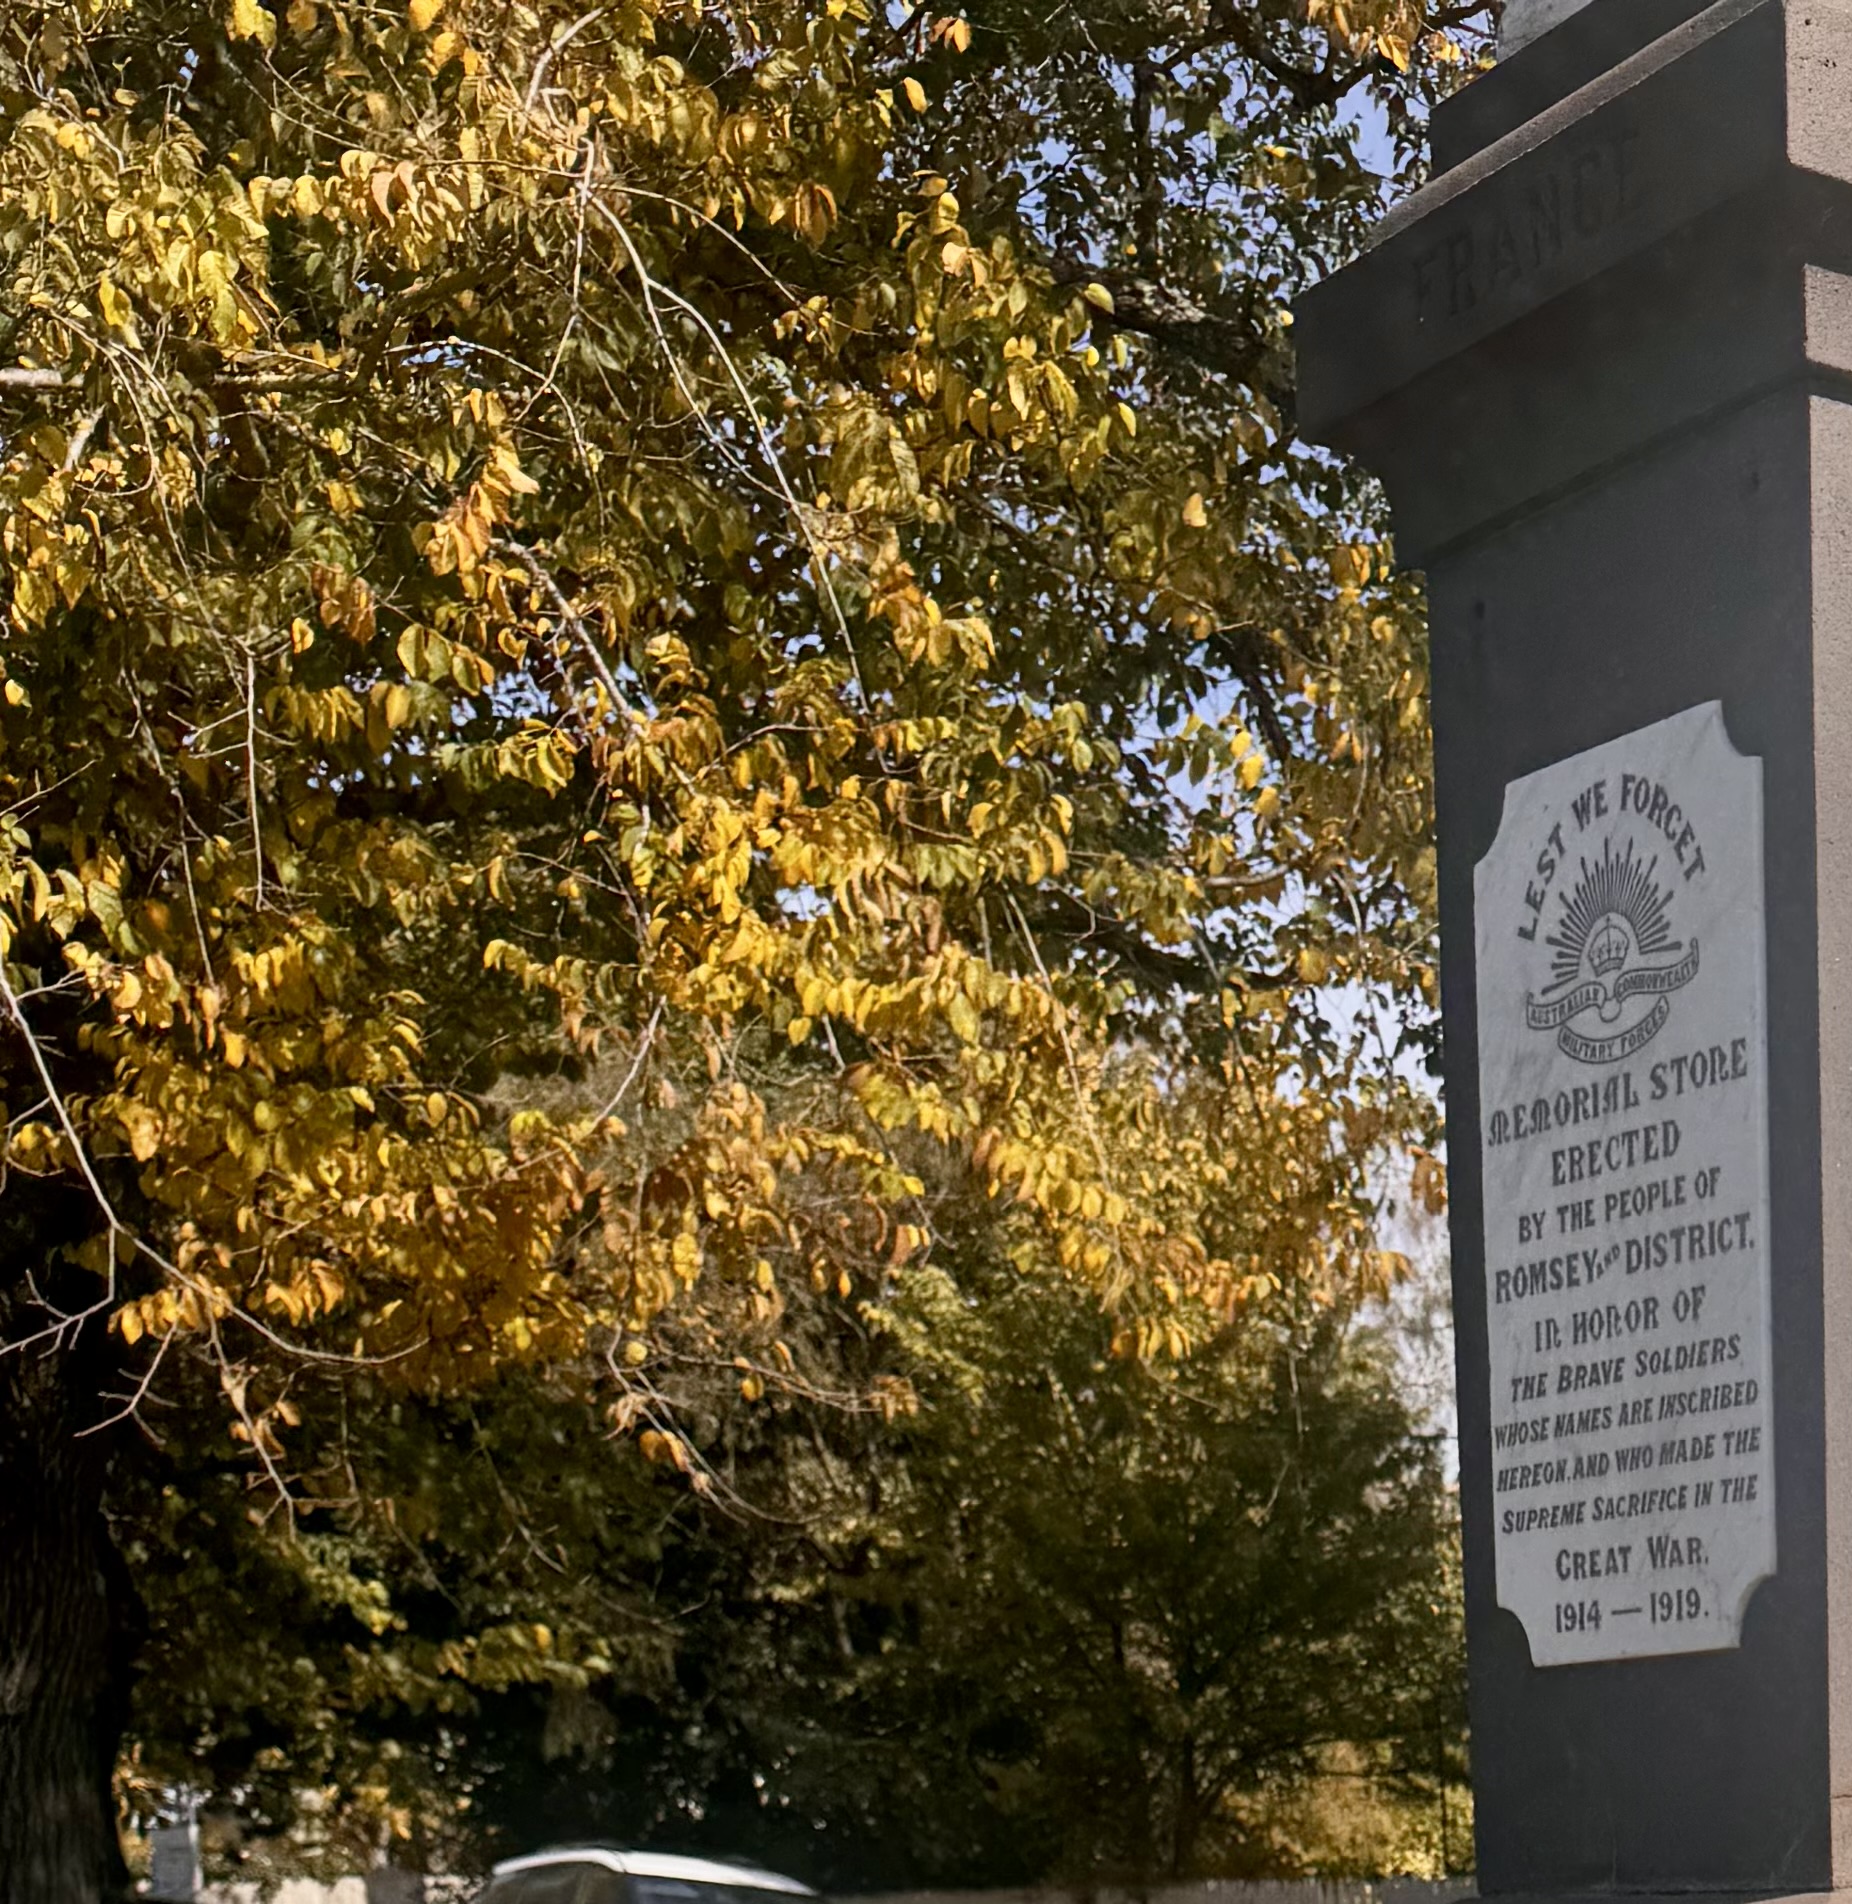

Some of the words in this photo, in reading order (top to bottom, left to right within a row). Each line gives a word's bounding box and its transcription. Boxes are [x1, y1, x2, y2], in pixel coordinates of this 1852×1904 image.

[1517, 821, 1566, 942] LEST
[1571, 779, 1609, 832] WE
[1561, 1033, 1615, 1060] MILITARY
[1620, 1005, 1665, 1054] FORCES
[1488, 1072, 1640, 1147] MEMORIAL
[1551, 1119, 1681, 1187] ERECTED
[1518, 1209, 1546, 1244] BY
[1556, 1199, 1596, 1234] THE
[1604, 1174, 1687, 1223] PEOPLE
[1694, 1166, 1721, 1200] OF
[1495, 1247, 1598, 1304] ROMSEY
[1625, 1211, 1755, 1275] DISTRICT.
[1572, 1296, 1660, 1345] HONOR
[1672, 1284, 1706, 1323] OF
[1510, 1372, 1549, 1403] THE
[1556, 1356, 1626, 1395] BRAVE
[1635, 1333, 1741, 1378] SOLDIERS
[1493, 1416, 1551, 1451] WHOSE
[1553, 1405, 1612, 1439] NAMES
[1617, 1397, 1654, 1428] ARE
[1659, 1379, 1759, 1421] INSCRIBED
[1615, 1444, 1654, 1474] WHO
[1659, 1434, 1716, 1467] MADE
[1723, 1426, 1762, 1457] THE
[1501, 1500, 1587, 1535] SUPREME
[1592, 1484, 1689, 1521] SACRIFICE
[1694, 1480, 1714, 1508] IN
[1719, 1473, 1758, 1504] THE
[1646, 1535, 1709, 1570] WAR.
[1555, 1600, 1603, 1634] 1914
